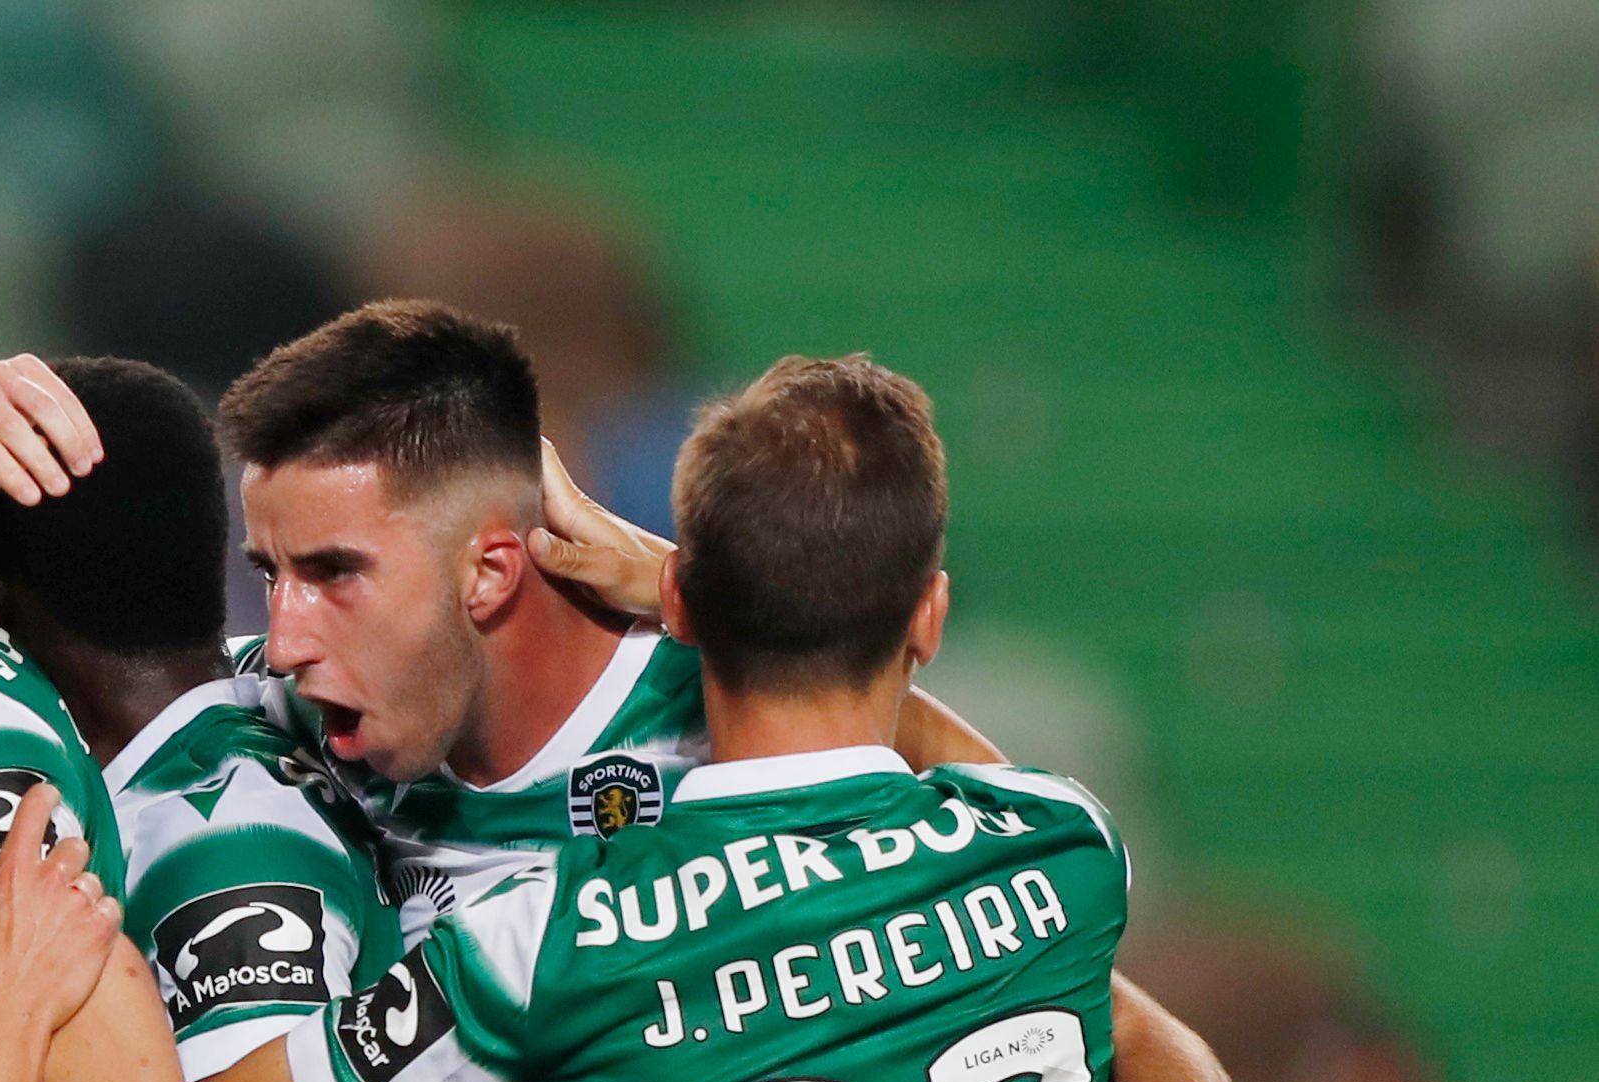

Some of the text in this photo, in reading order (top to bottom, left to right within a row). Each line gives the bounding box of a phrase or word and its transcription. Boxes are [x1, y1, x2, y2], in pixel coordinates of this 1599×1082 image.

[578, 763, 652, 792] SPORTING
[575, 832, 844, 948] SUPER
[641, 867, 1069, 1050] J. PEREIRA
[175, 960, 314, 1014] A MatosCar
[963, 1047, 1005, 1070] LIGA
